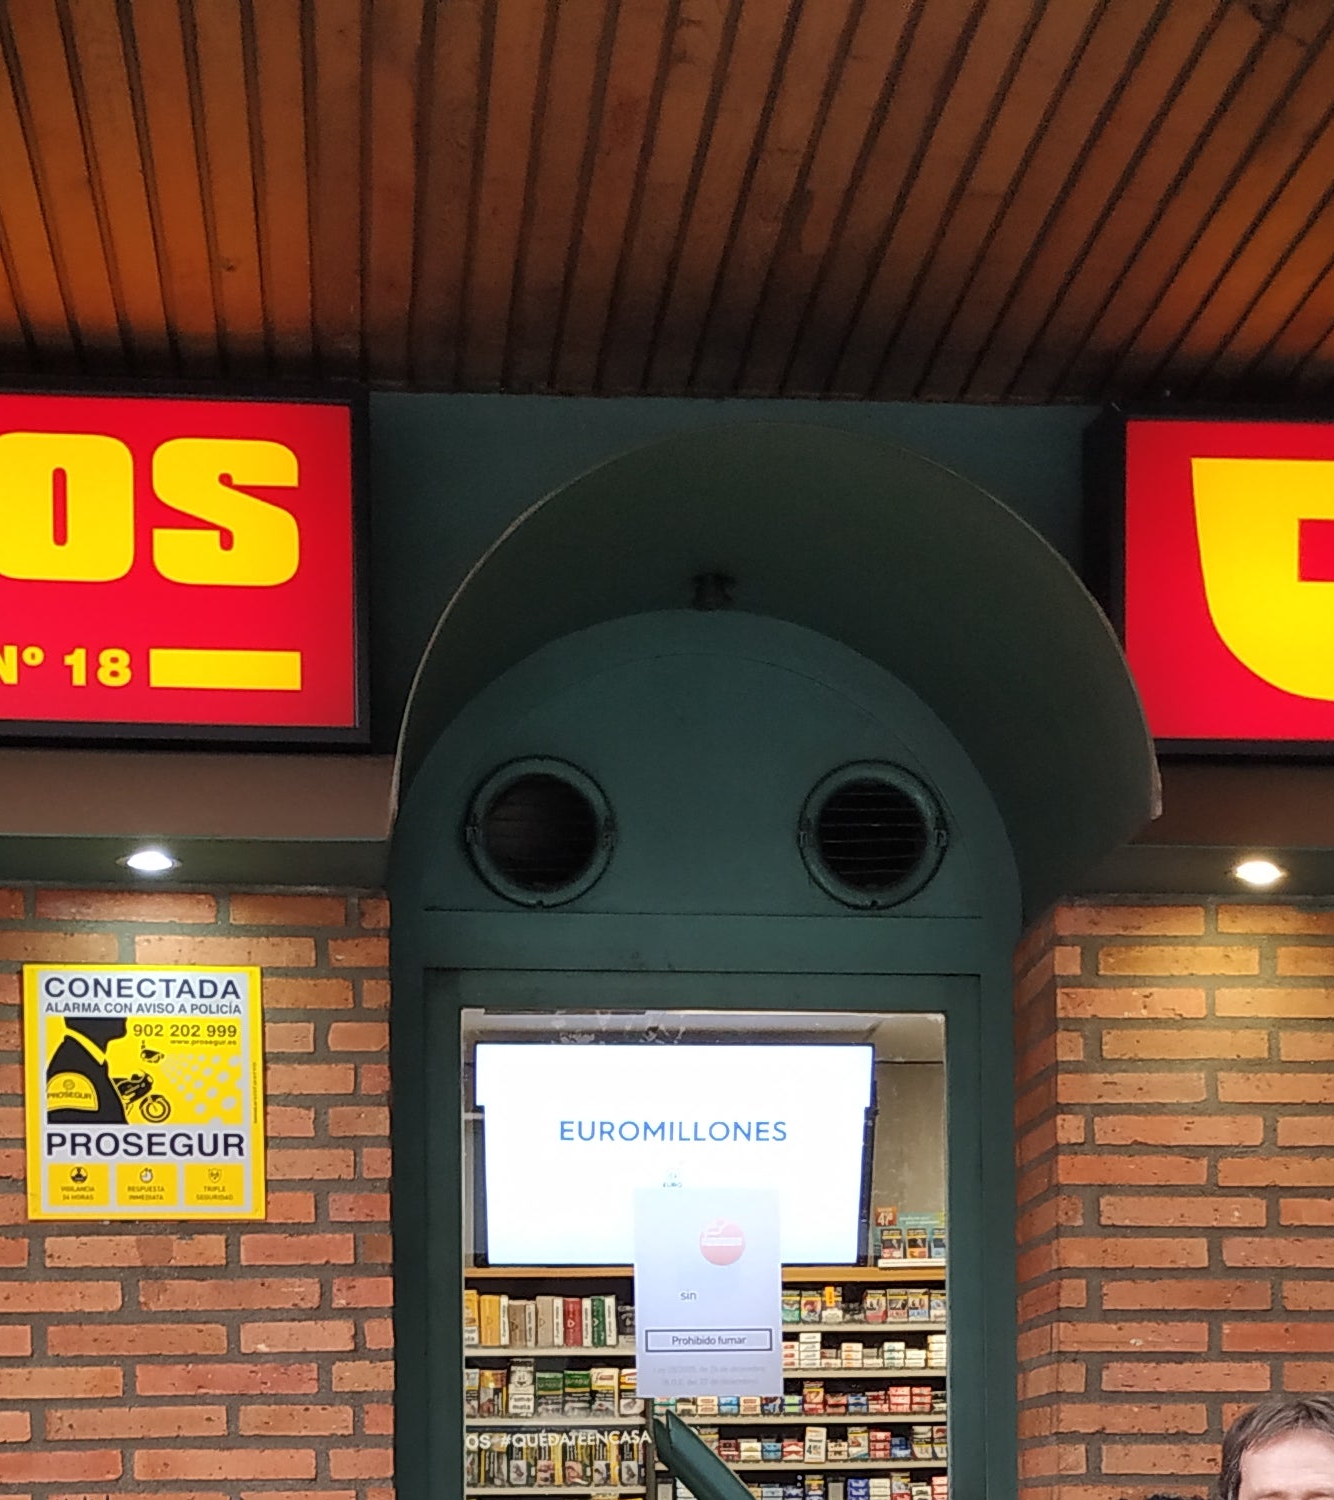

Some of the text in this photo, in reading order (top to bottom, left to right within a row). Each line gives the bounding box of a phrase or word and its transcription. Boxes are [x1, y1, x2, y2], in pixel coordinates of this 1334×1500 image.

[64, 646, 133, 688] 18
[44, 976, 241, 1000] CONECTADA
[45, 1002, 242, 1015] ALARMA CON AVISO A POLICÍA
[133, 1024, 237, 1038] 902 202 999
[47, 1091, 92, 1100] PROSEGUR
[559, 1120, 787, 1142] EUROMILLONES
[46, 1132, 245, 1157] PROSEGUR
[680, 1290, 697, 1301] sin
[671, 1335, 747, 1345] Prohibido fumar
[500, 1429, 653, 1448] #QUÉDATEENCASA
